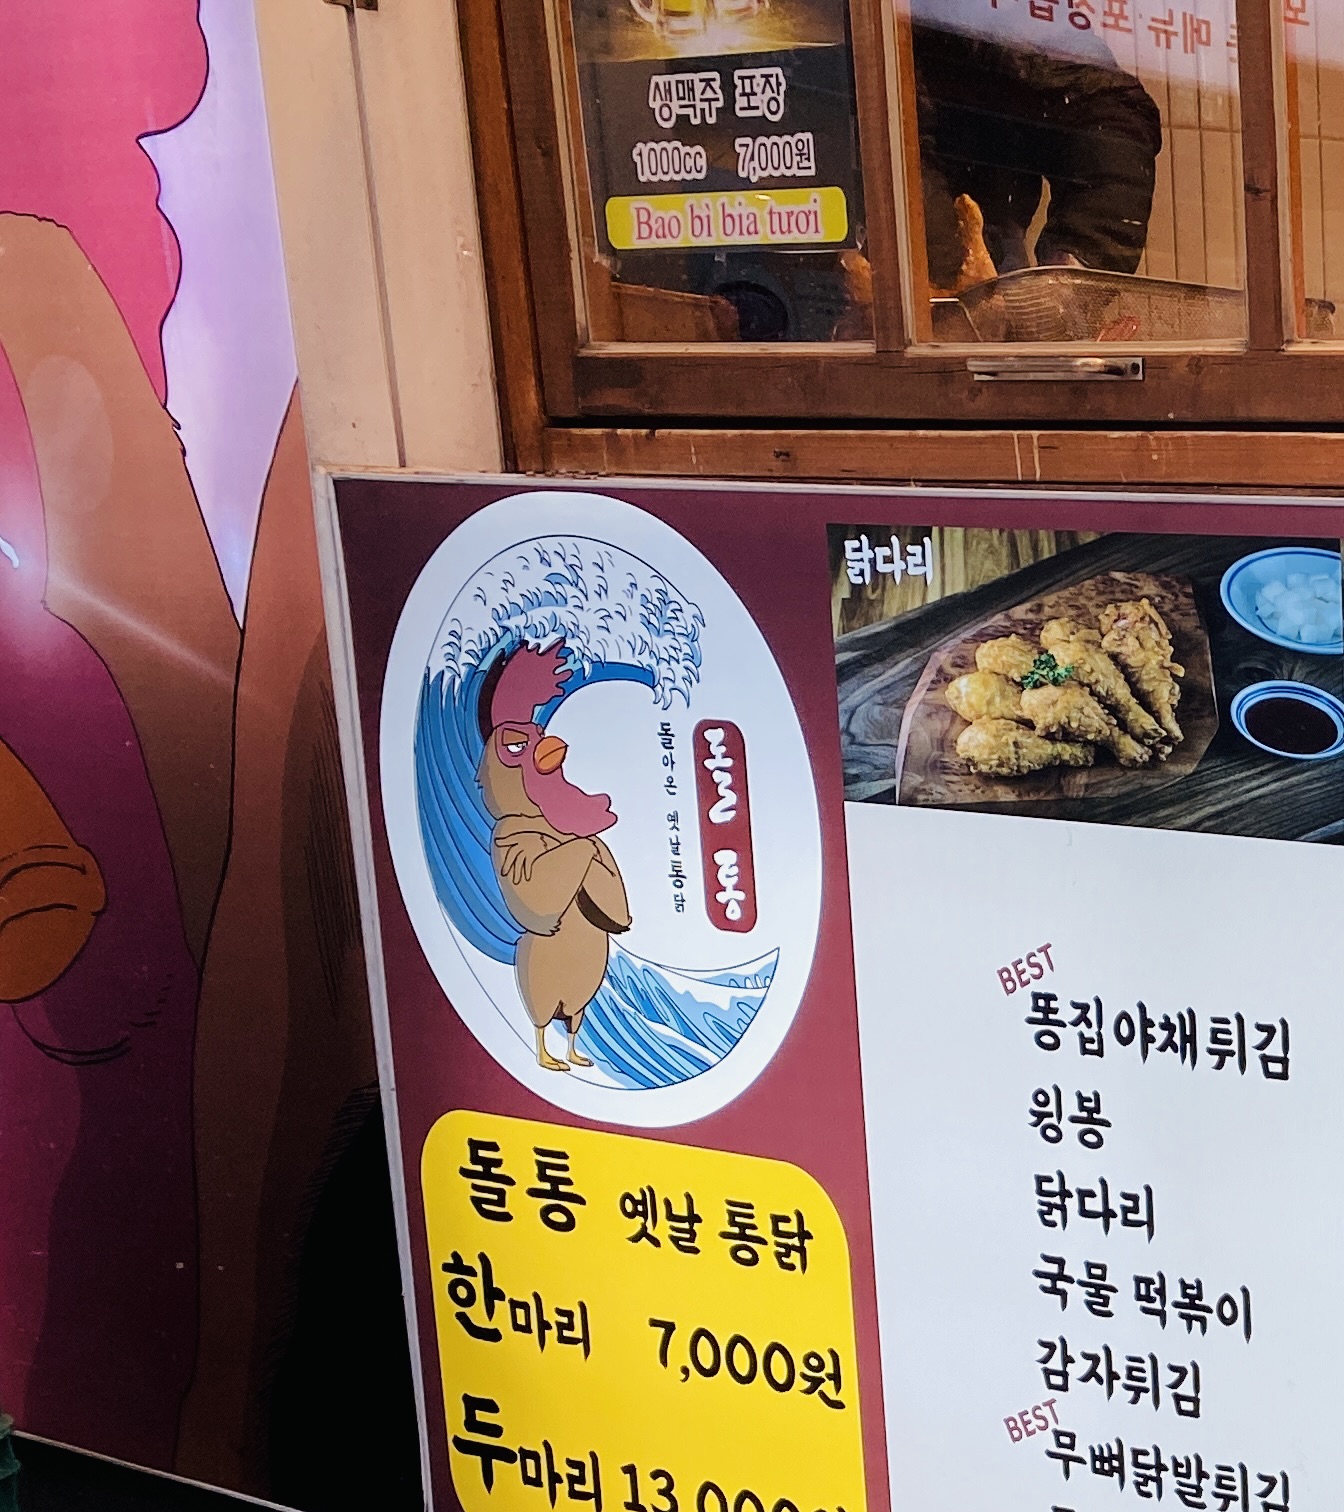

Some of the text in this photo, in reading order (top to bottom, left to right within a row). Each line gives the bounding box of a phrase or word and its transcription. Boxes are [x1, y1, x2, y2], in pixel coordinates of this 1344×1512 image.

[651, 72, 783, 123] 생맥주 포장
[635, 146, 704, 177] 1000cc
[737, 137, 812, 178] 7,000원
[634, 197, 821, 241] Bao bì bia tươi
[843, 535, 935, 588] 닭다리
[995, 943, 1058, 997] BEST
[1028, 1083, 1113, 1150] 윙봉
[458, 1137, 814, 1274] 돌통 옛날 통닭
[1033, 1169, 1155, 1244] 닭다리
[1031, 1253, 1252, 1344] 국물 떡볶이
[441, 1250, 846, 1410] 한마리 7,000원
[1035, 1335, 1203, 1418] 감자튀김
[1002, 1398, 1063, 1444] BEST
